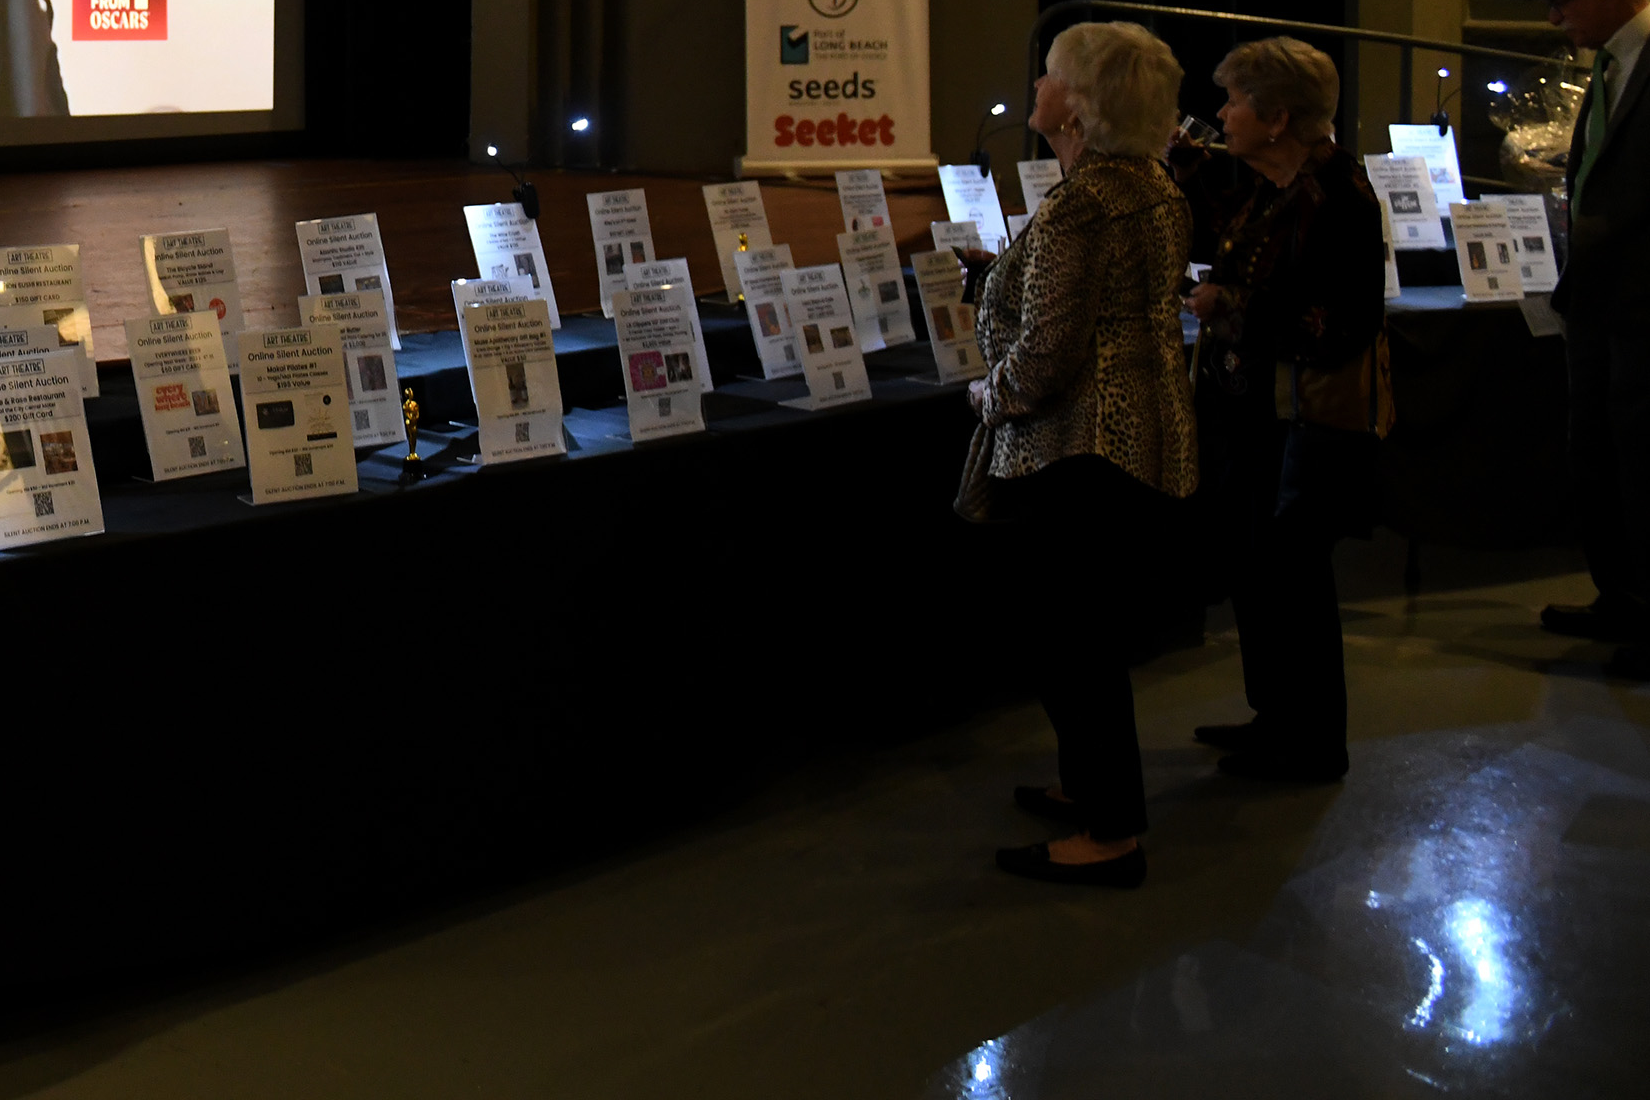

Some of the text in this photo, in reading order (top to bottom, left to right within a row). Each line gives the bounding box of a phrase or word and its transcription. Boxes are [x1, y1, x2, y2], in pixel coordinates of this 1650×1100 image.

[90, 11, 149, 29] OSCARS
[814, 29, 845, 38] Port of
[814, 41, 888, 50] LONG BEACH
[789, 72, 876, 99] seeds
[518, 319, 543, 329] Auction
[248, 346, 333, 361] Online Silent Auction
[8, 379, 33, 390] Silent
[35, 375, 69, 387] Auction
[28, 391, 66, 403] Restaurant
